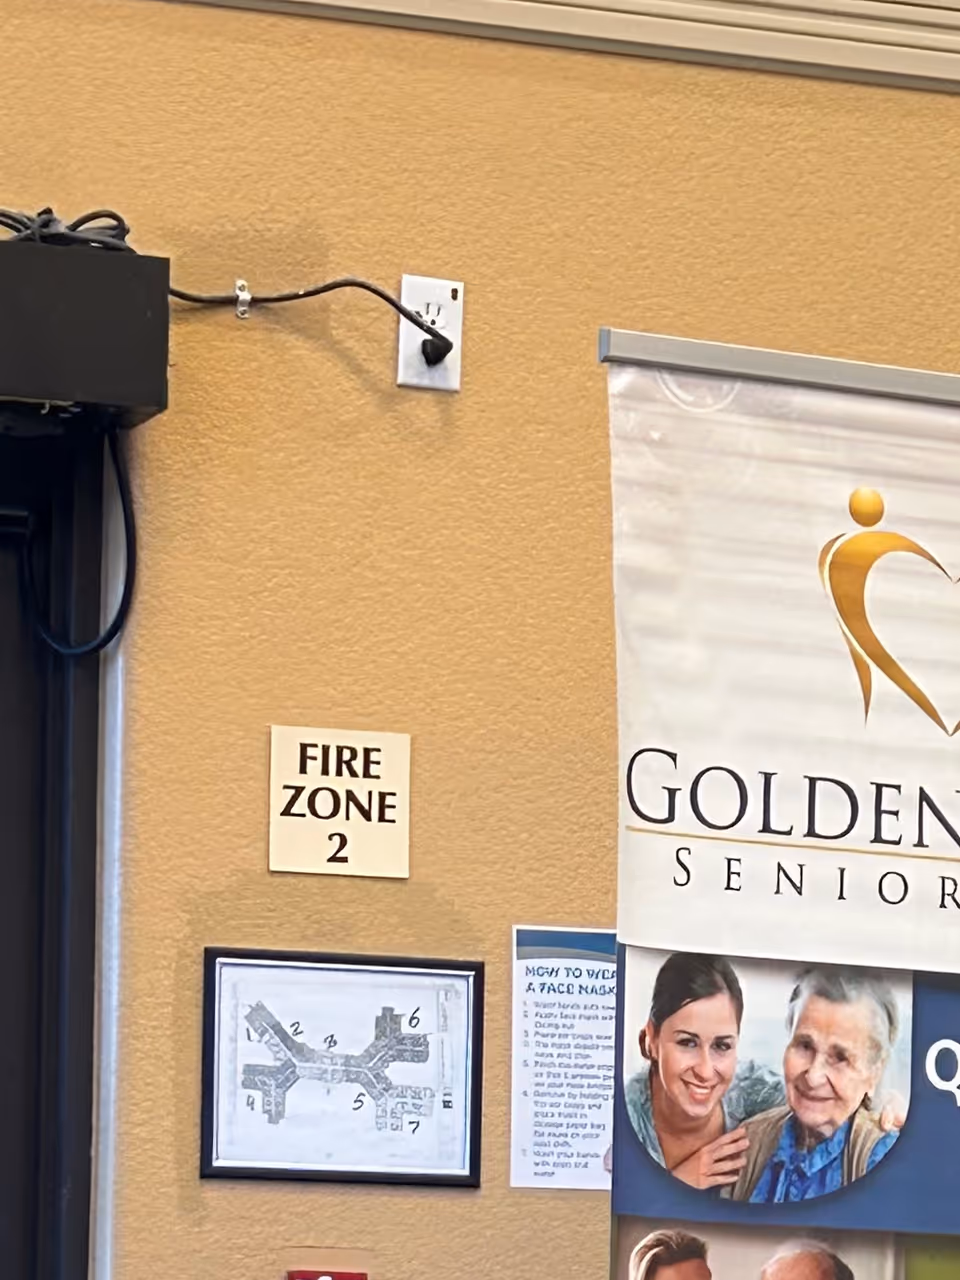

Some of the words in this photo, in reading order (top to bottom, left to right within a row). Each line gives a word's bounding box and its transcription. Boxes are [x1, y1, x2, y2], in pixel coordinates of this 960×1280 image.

[298, 742, 382, 780] FIRE
[279, 784, 398, 824] ZONE
[326, 832, 349, 864] 2
[408, 1006, 421, 1029] 6
[351, 1092, 366, 1112] 5
[407, 1120, 421, 1136] 7
